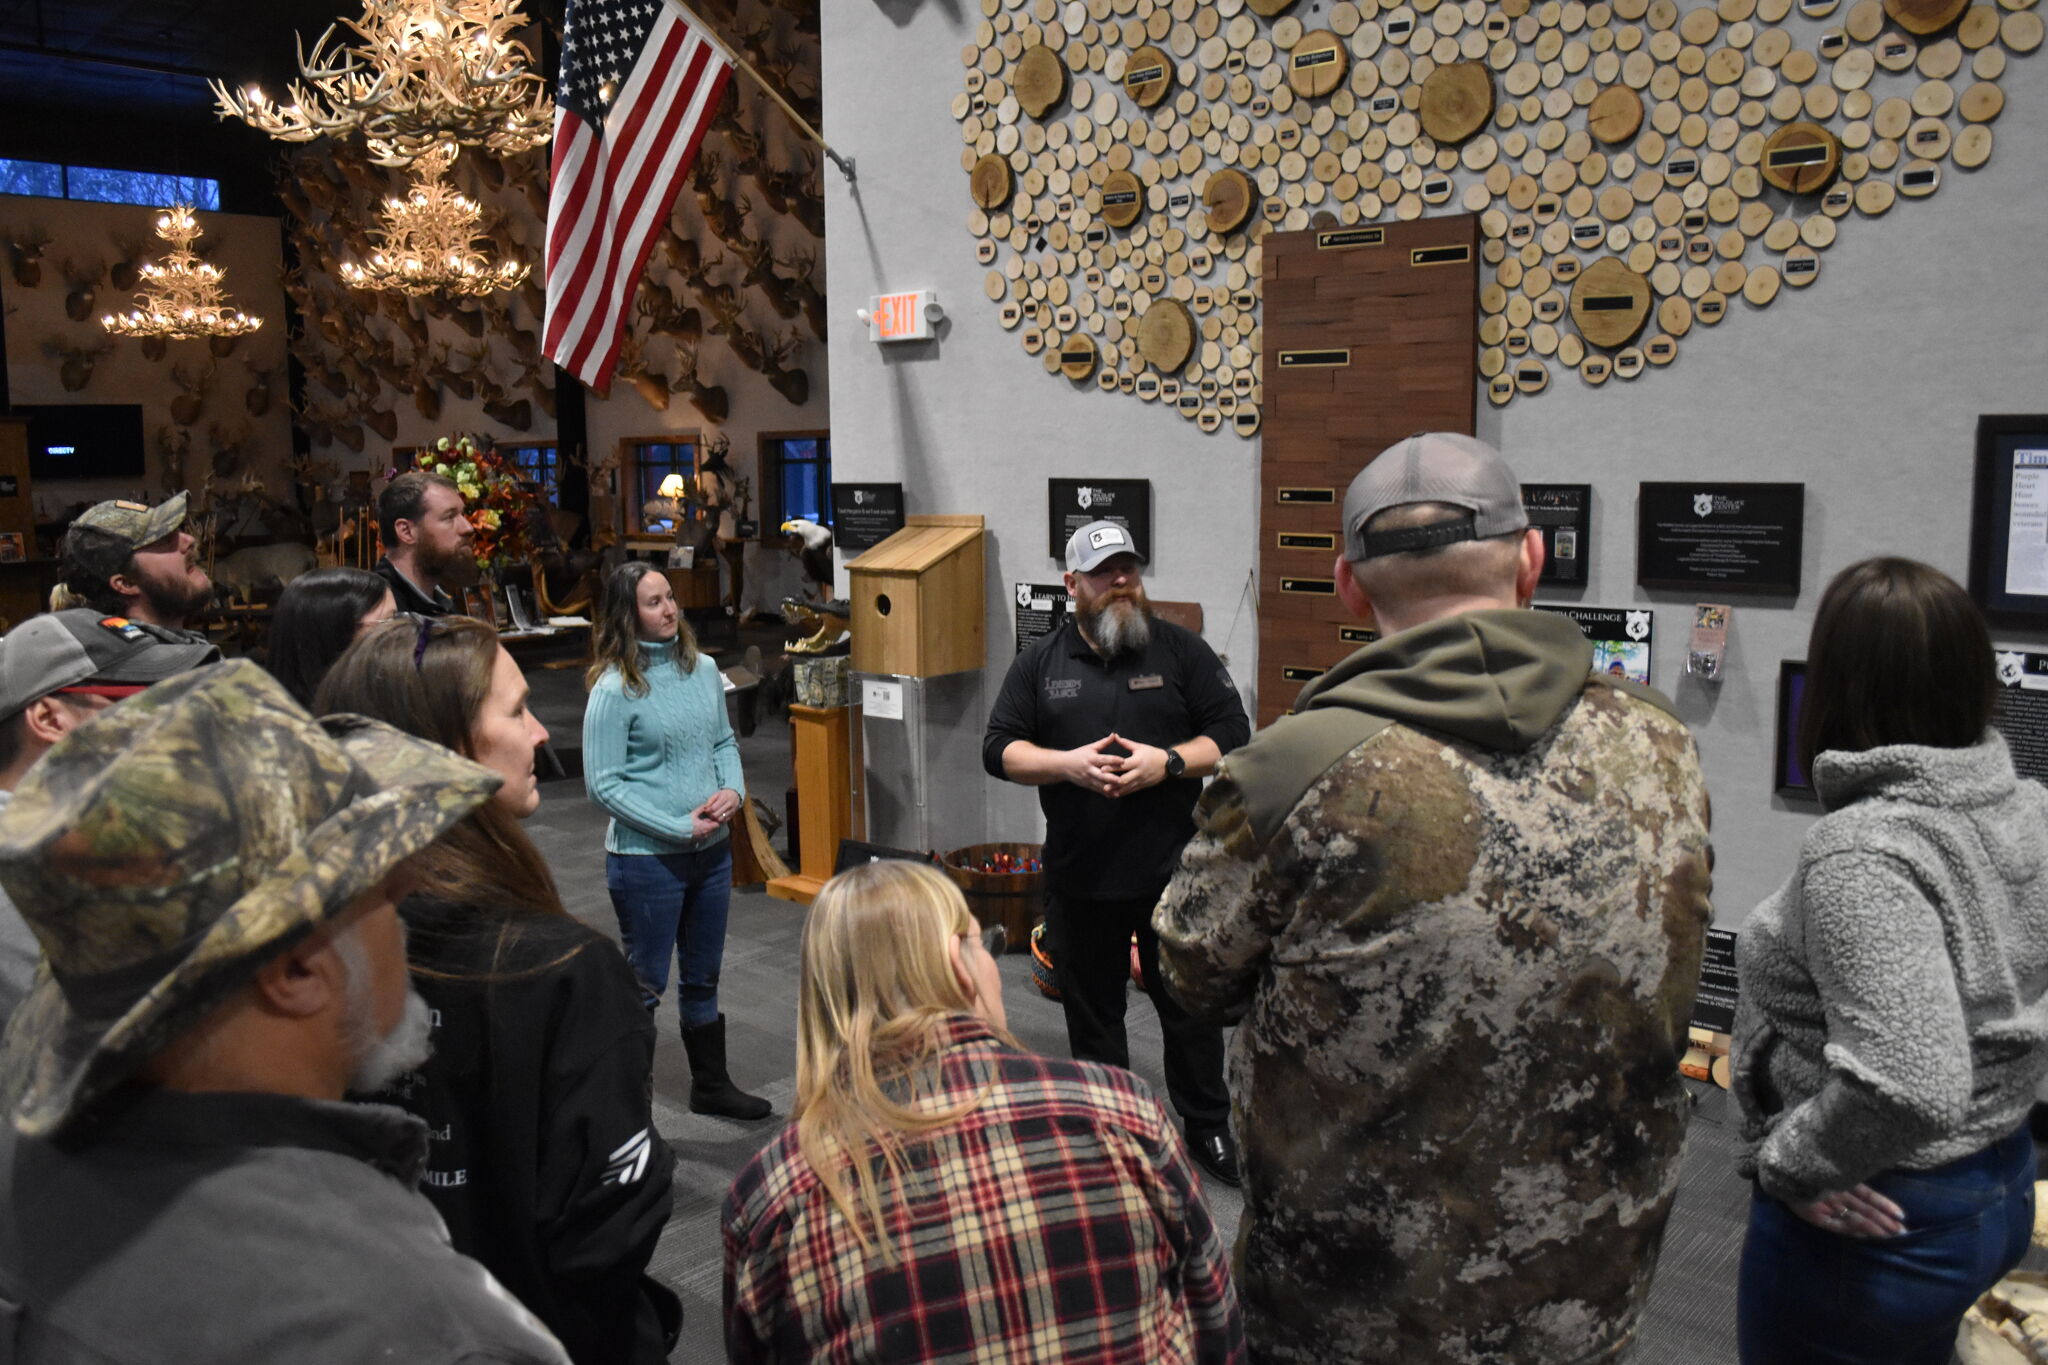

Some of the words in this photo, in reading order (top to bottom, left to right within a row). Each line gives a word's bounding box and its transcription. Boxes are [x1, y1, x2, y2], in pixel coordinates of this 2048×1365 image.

[880, 294, 918, 337] EXIT
[1034, 592, 1055, 602] LEARN
[1056, 594, 1066, 602] TO
[1568, 610, 1622, 623] CHALLENGE
